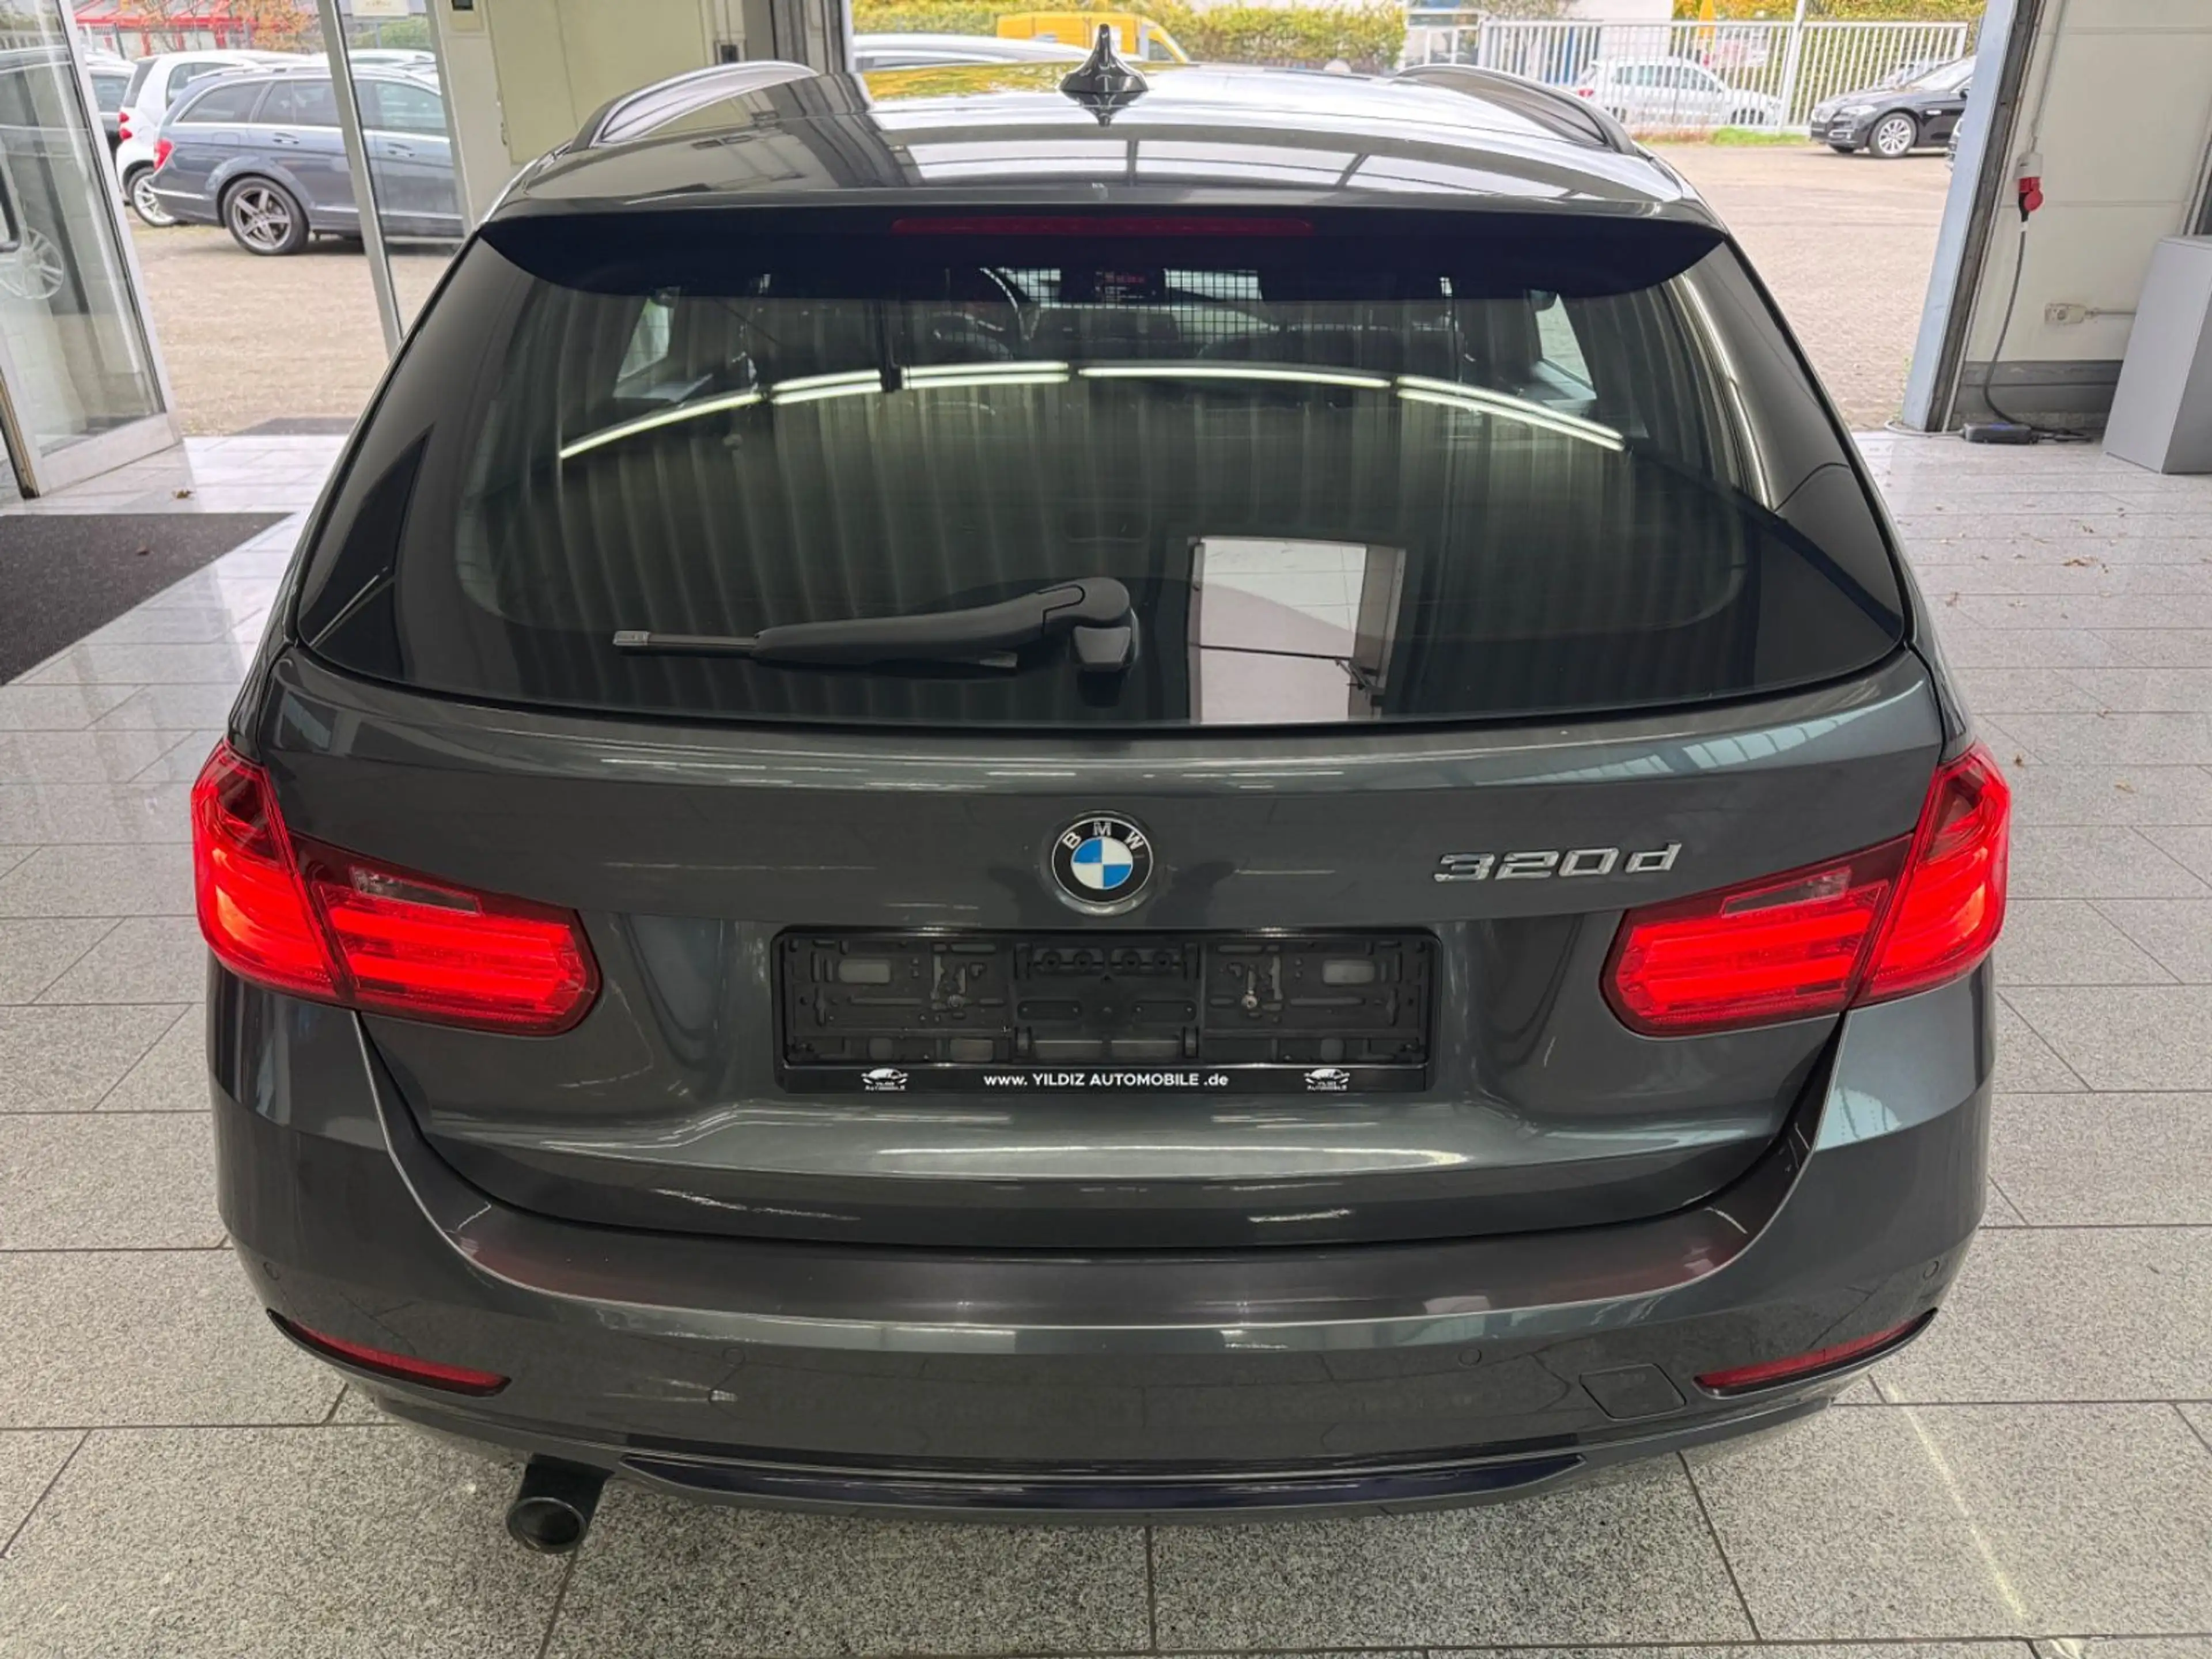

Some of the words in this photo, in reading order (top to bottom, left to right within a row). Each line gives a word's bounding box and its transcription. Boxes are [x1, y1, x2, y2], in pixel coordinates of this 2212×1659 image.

[1062, 821, 1144, 850] BMW
[983, 1075, 1028, 1086] www.
[1032, 1073, 1085, 1086] YILDIZ
[1089, 1073, 1199, 1086] AUTOMOBILE
[1204, 1073, 1229, 1086] .de
